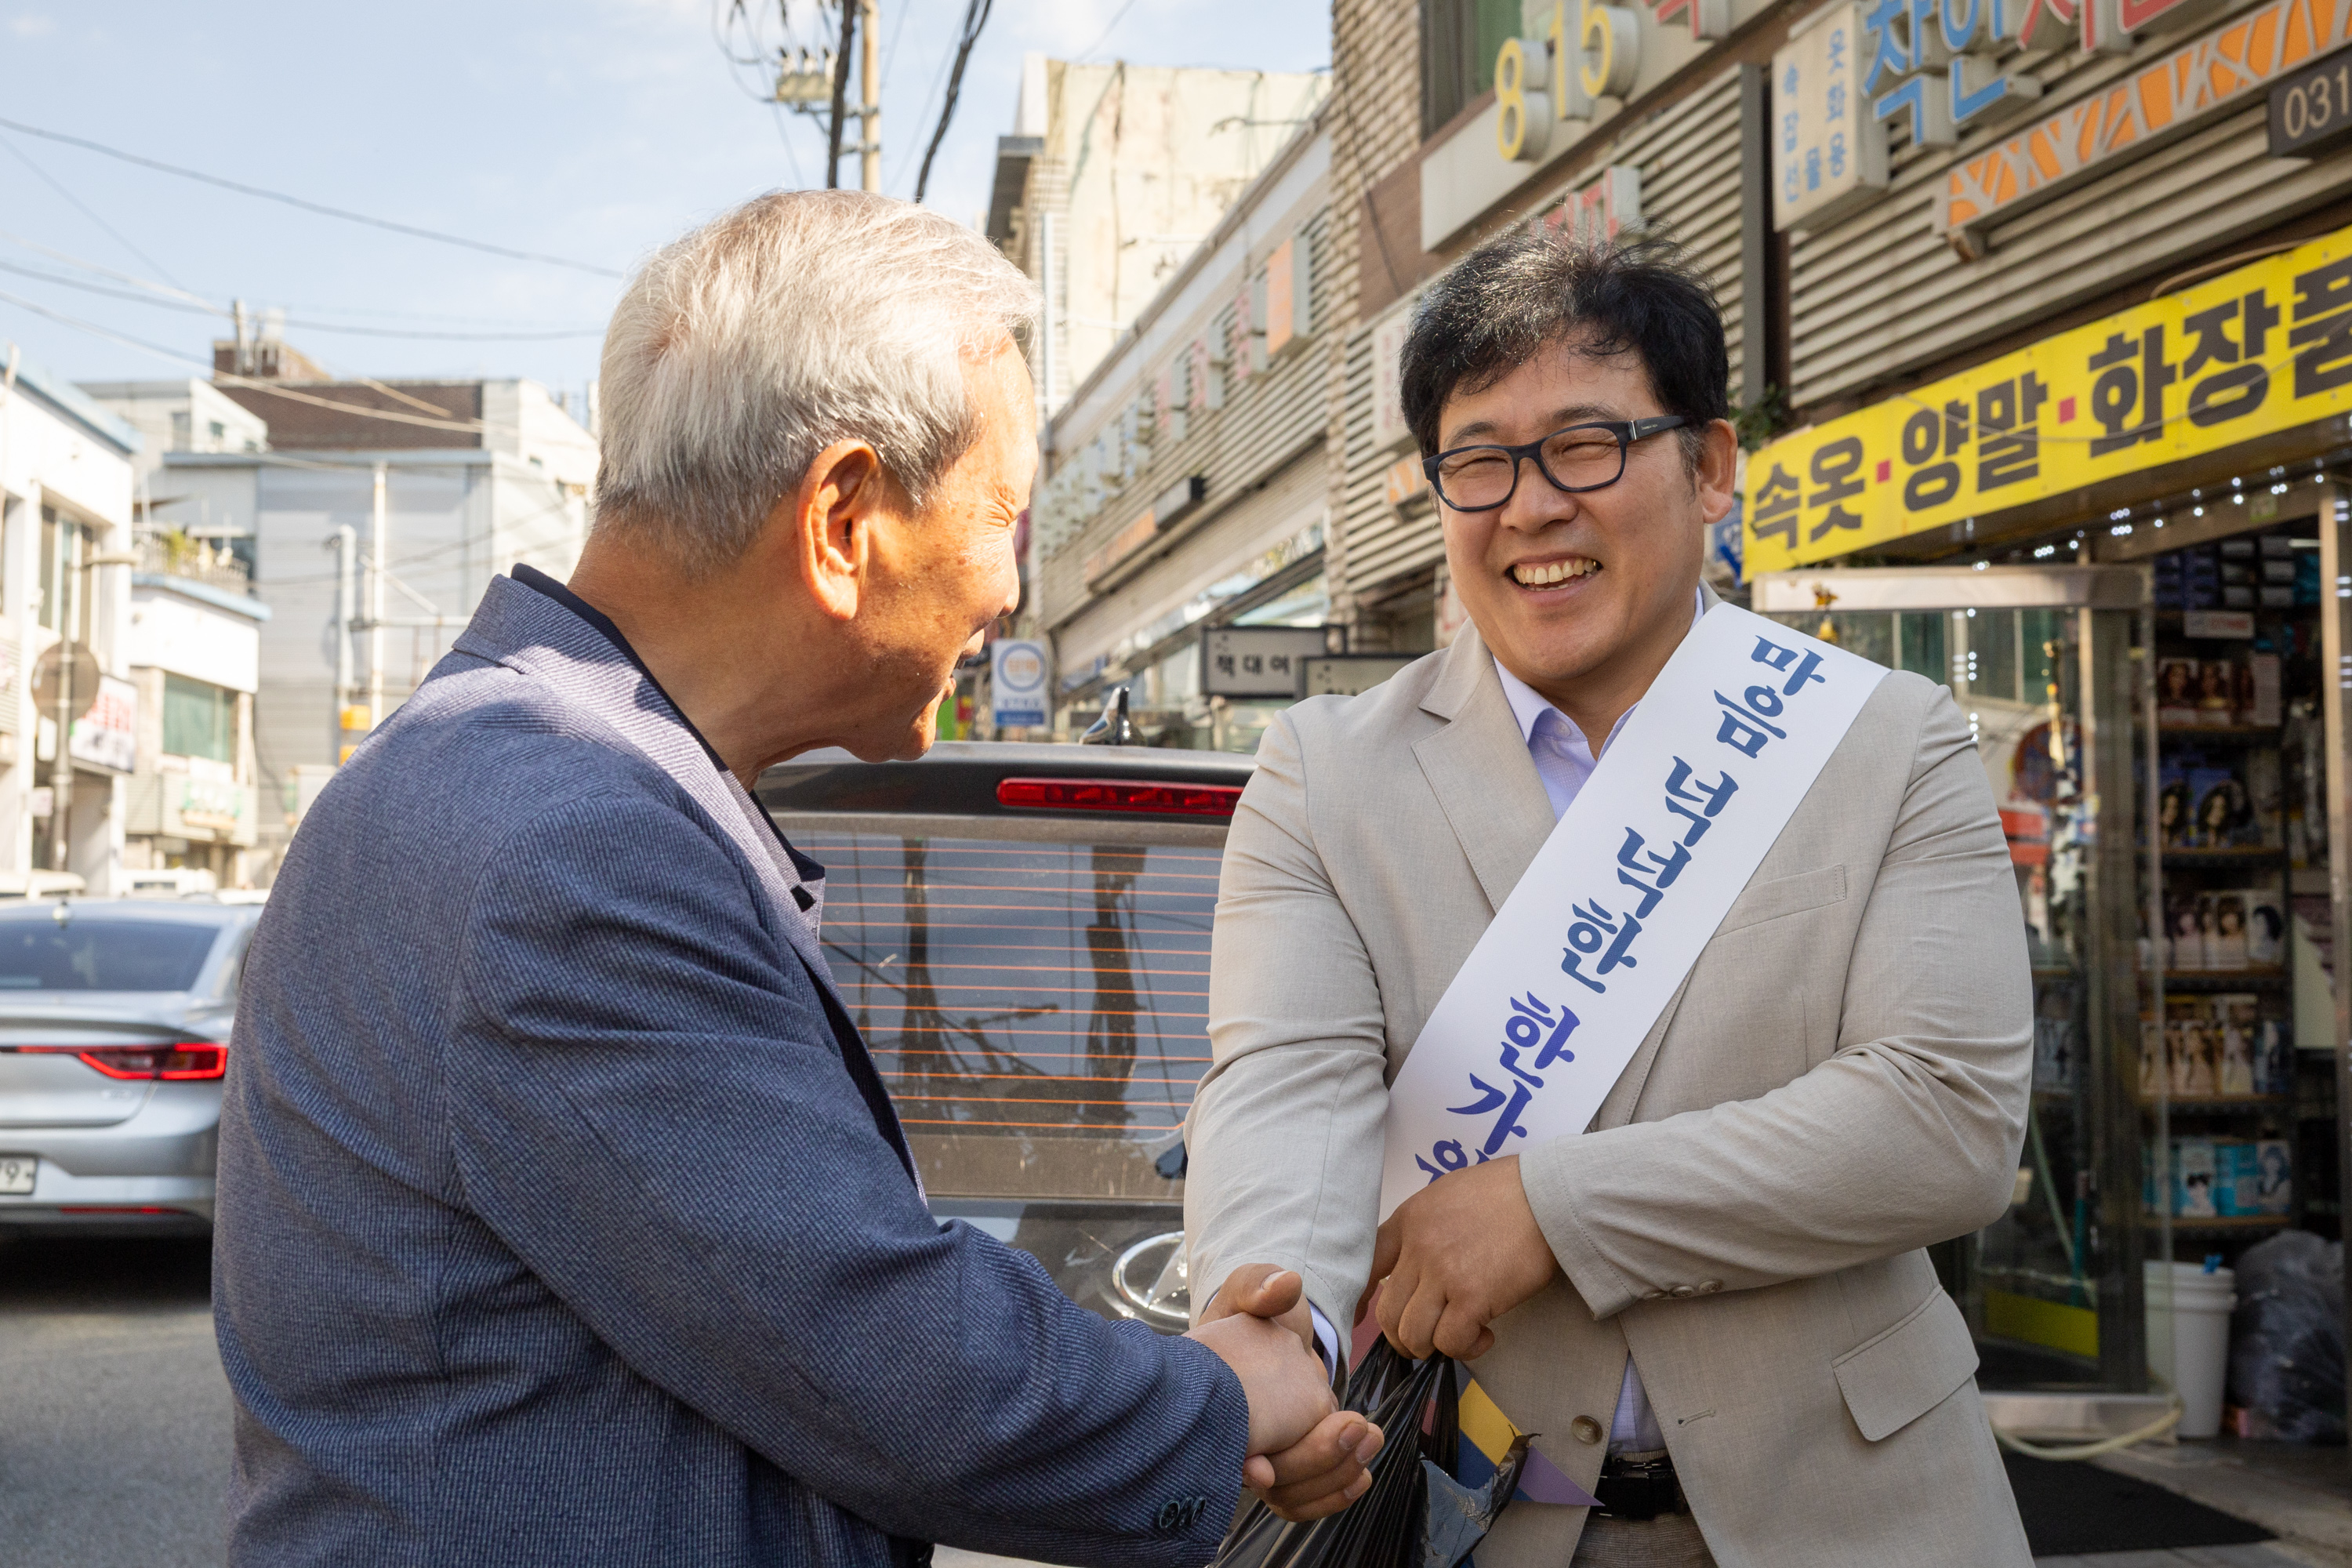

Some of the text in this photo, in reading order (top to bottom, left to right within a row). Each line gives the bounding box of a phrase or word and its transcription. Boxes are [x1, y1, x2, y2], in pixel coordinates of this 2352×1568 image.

[1753, 436, 1866, 550] 속옷
[1900, 369, 2049, 514] 양말
[1714, 634, 1826, 759] 마음
[1561, 755, 1740, 994] 넉넉한
